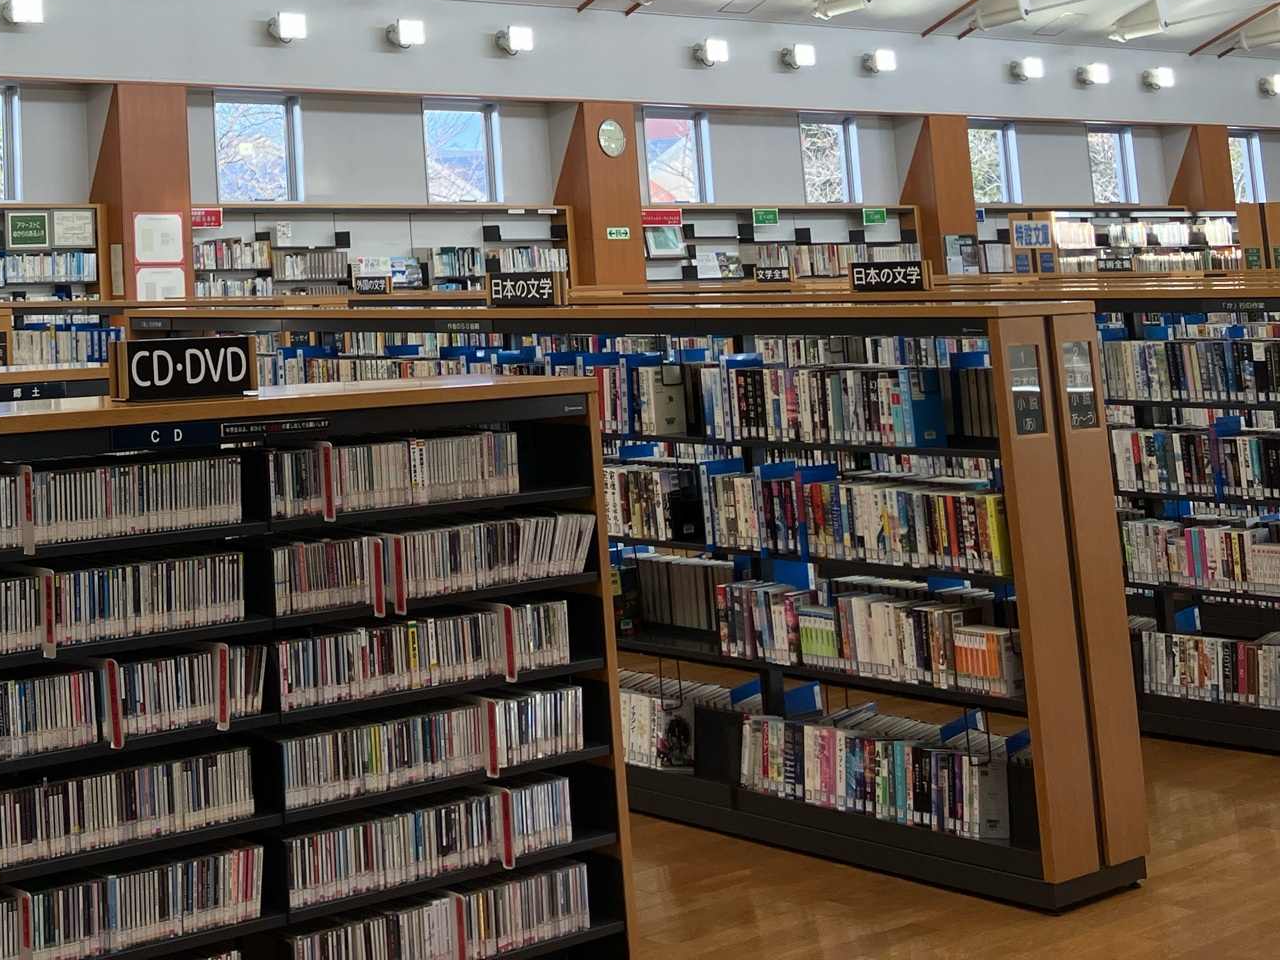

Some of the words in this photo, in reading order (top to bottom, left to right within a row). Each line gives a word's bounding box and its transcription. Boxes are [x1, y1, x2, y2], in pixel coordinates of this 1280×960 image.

[1015, 224, 1050, 247] 特設文庫
[1098, 259, 1132, 269] 美術全集
[756, 269, 790, 279] 文学全集
[853, 266, 921, 285] 日本の文学
[356, 279, 386, 290] 外国の文学
[491, 277, 553, 299] 日本の文学
[1019, 352, 1025, 364] 1
[1072, 347, 1080, 360] 2
[1067, 372, 1091, 386] 日本の
[1017, 396, 1039, 411] 小説
[1071, 393, 1092, 406] 小説
[1023, 417, 1036, 431] (あ)
[150, 428, 183, 443] CD
